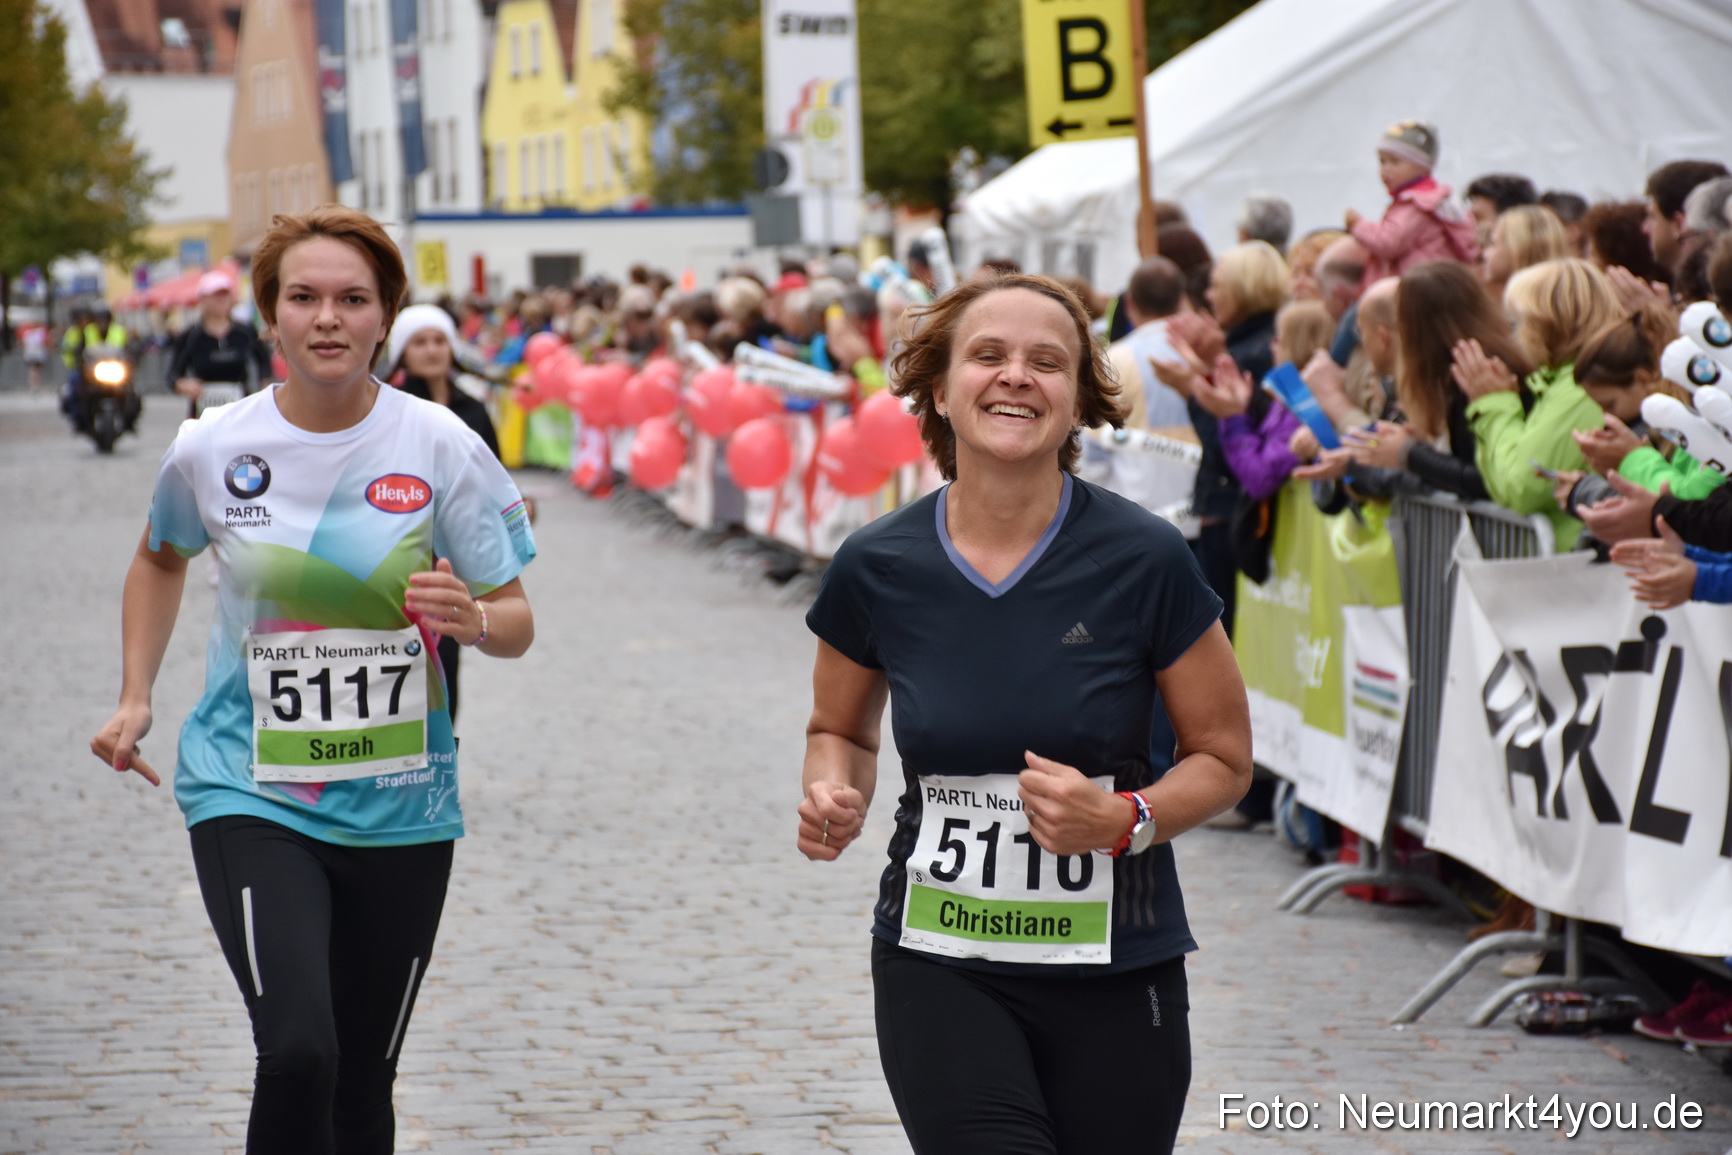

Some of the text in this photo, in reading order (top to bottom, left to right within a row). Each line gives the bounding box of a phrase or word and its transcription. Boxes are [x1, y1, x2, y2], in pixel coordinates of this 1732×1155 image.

[1058, 17, 1115, 101] B
[375, 483, 424, 504] Hervis
[225, 506, 271, 519] PARTL
[224, 519, 272, 529] Neumarkt
[1061, 635, 1094, 644] adidas
[253, 643, 397, 661] PARTL Neumarkt
[270, 664, 411, 722] 5117
[261, 717, 268, 727] S
[309, 736, 374, 760] Sarah
[375, 766, 437, 789] Stadtlauf
[927, 787, 1025, 811] PARTL Neu
[915, 871, 923, 883] S
[939, 900, 1072, 938] Christiane
[1147, 985, 1161, 1026] Reebok
